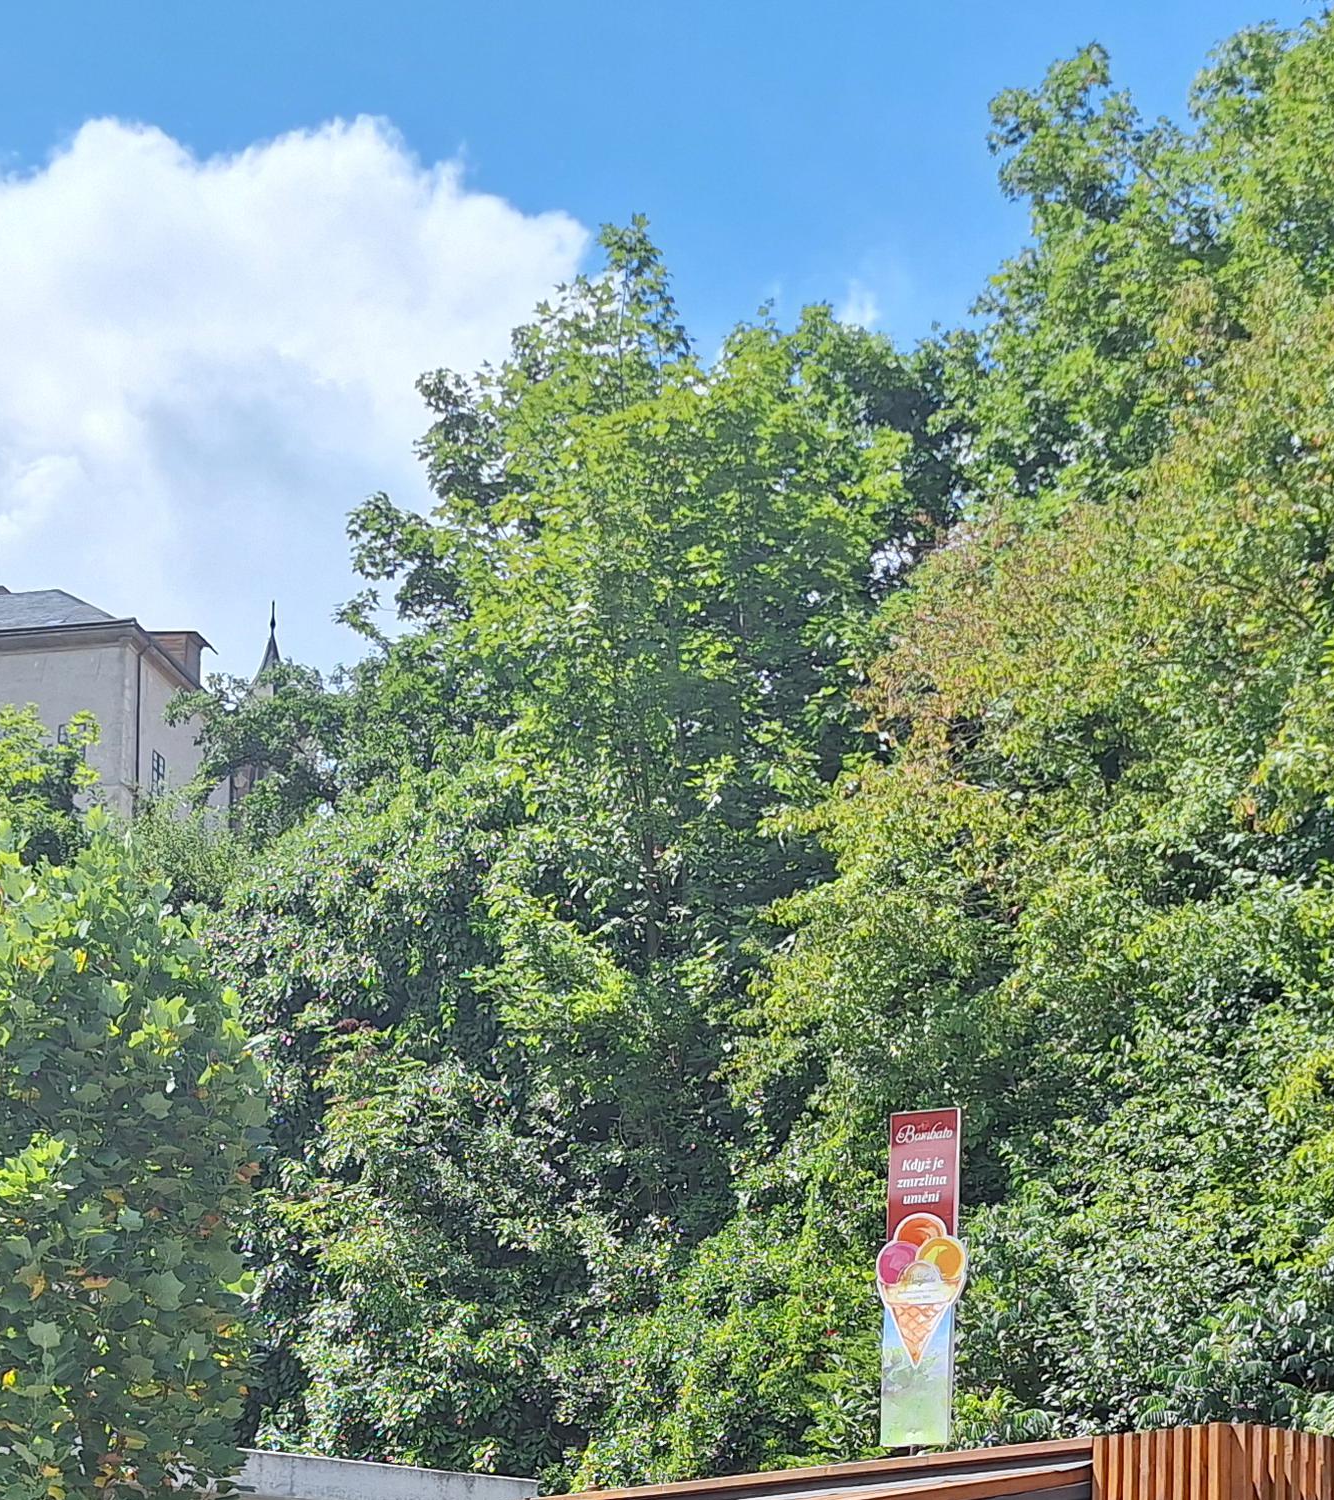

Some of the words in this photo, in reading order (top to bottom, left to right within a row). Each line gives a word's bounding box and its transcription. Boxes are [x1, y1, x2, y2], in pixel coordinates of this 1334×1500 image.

[896, 1122, 953, 1144] Bombato
[902, 1158, 931, 1173] Když
[932, 1157, 945, 1172] je
[896, 1174, 948, 1188] zmrzlina
[902, 1191, 941, 1205] umění
